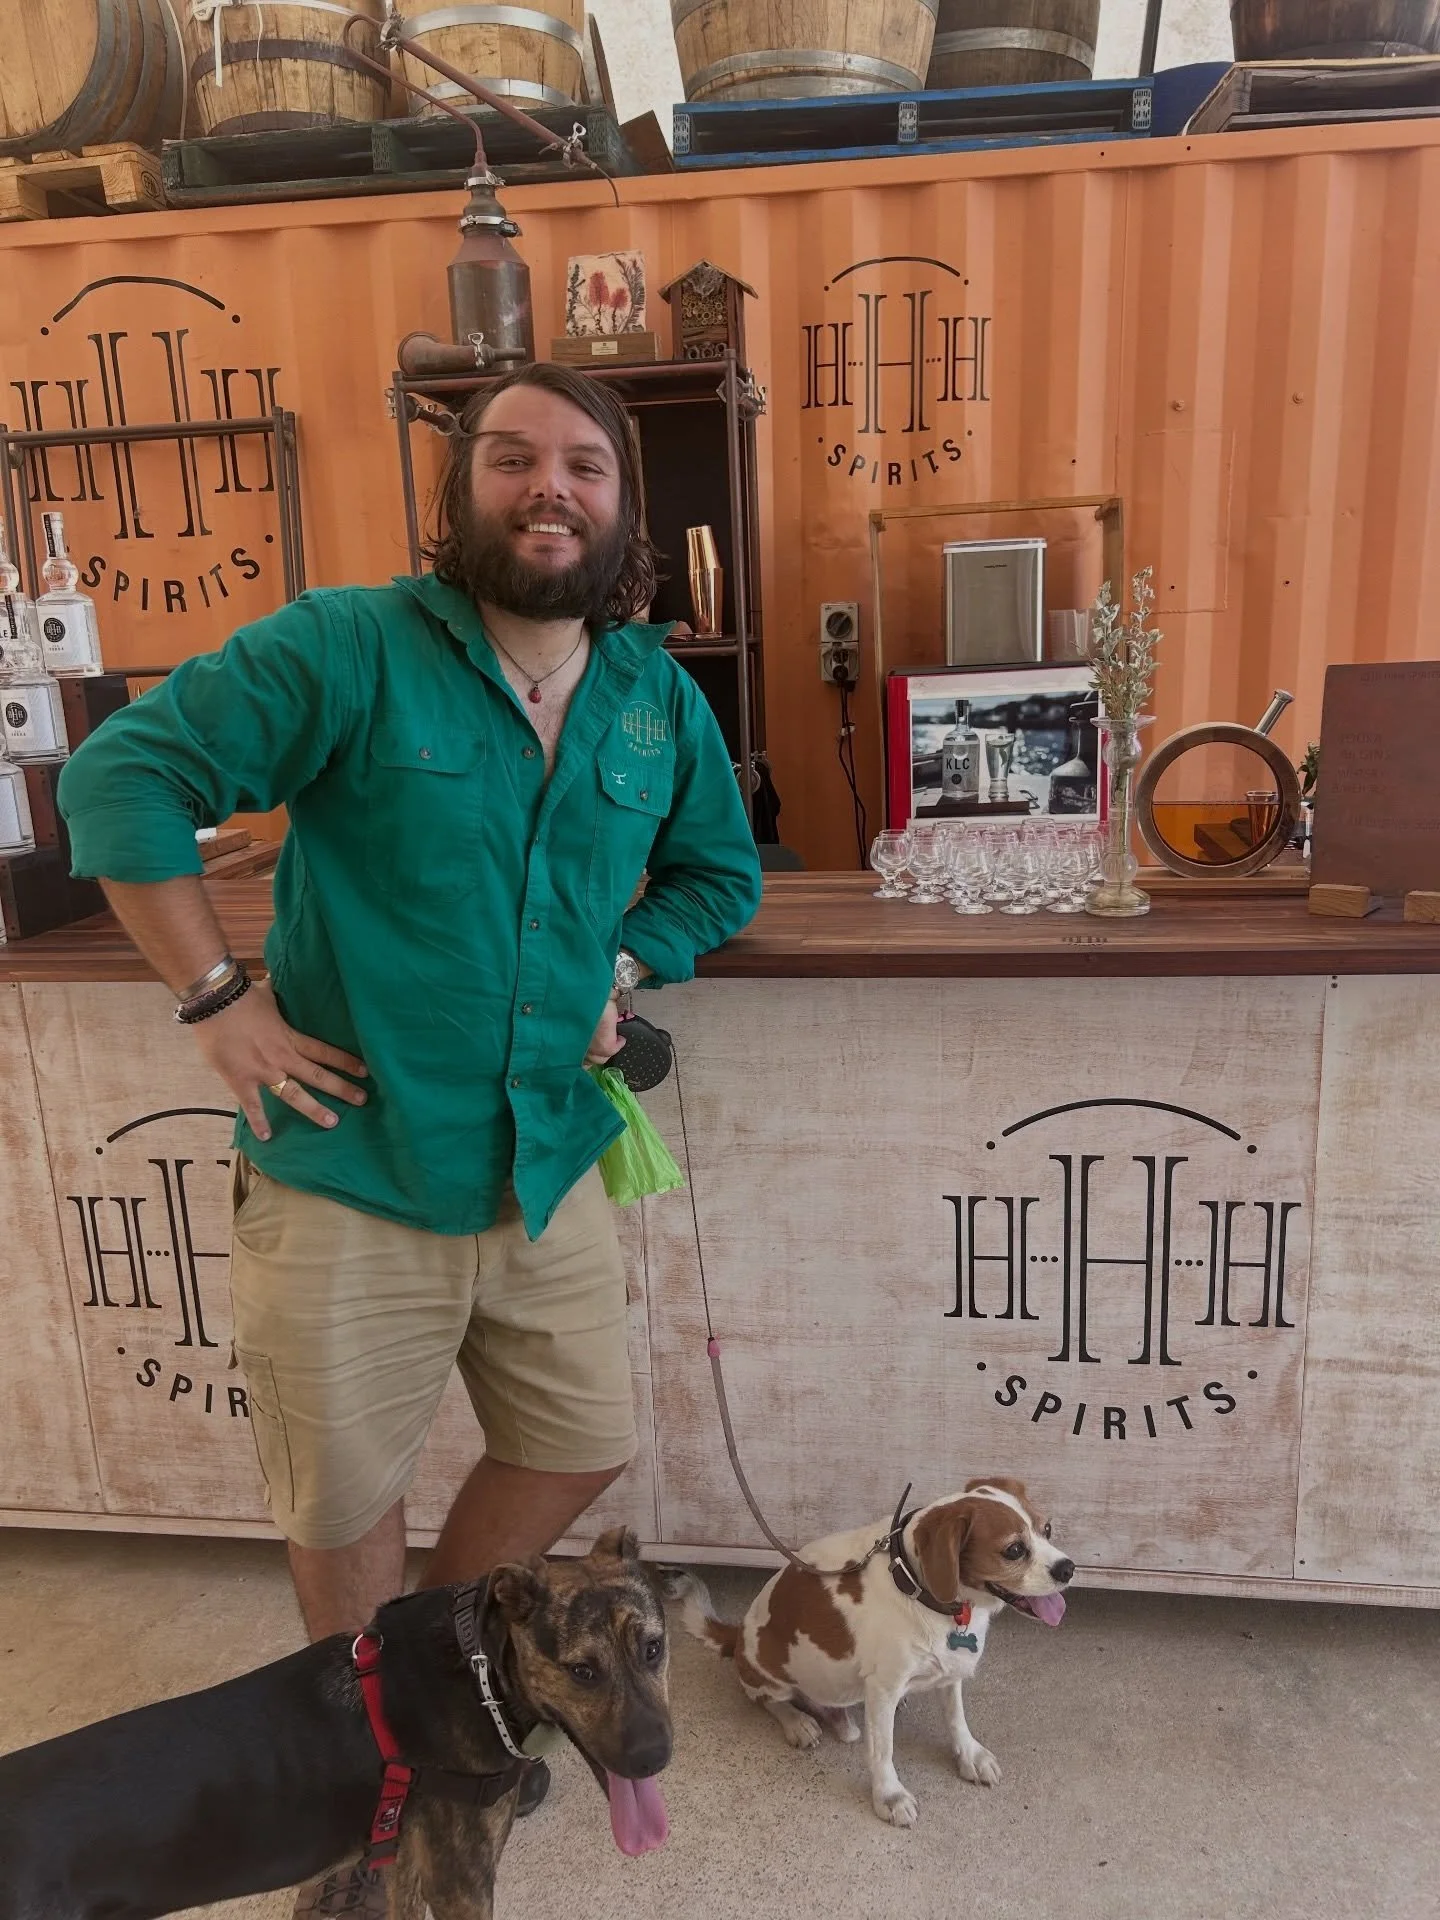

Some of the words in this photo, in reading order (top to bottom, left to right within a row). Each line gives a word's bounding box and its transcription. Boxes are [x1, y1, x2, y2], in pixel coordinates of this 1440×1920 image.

[828, 438, 962, 486] SPIRITS
[81, 547, 260, 613] SPIRITS
[946, 757, 970, 770] KLC
[136, 1358, 250, 1418] SPIR
[994, 1374, 1236, 1440] SPIRITS
